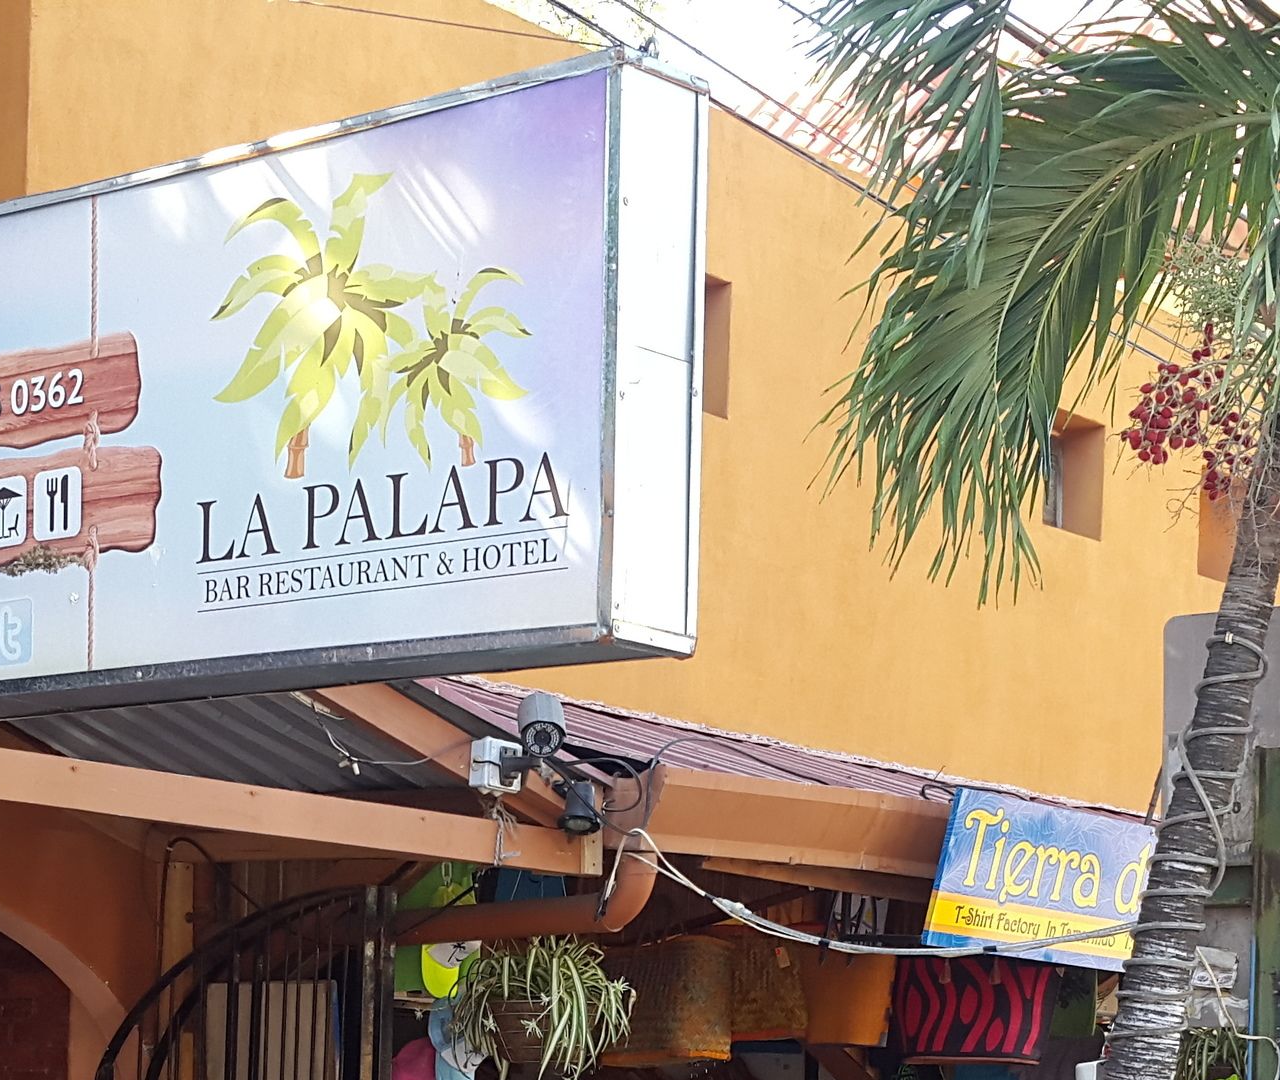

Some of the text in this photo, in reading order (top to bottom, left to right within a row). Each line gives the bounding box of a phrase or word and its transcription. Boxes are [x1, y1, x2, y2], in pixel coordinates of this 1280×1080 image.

[10, 368, 84, 415] 0362
[195, 451, 570, 565] LA PALAPA
[203, 538, 558, 604] BAR RESTAURANT & HOTEL
[963, 807, 1101, 905] Tierra
[954, 905, 994, 929] T-Shirt
[996, 912, 1041, 940] Factory
